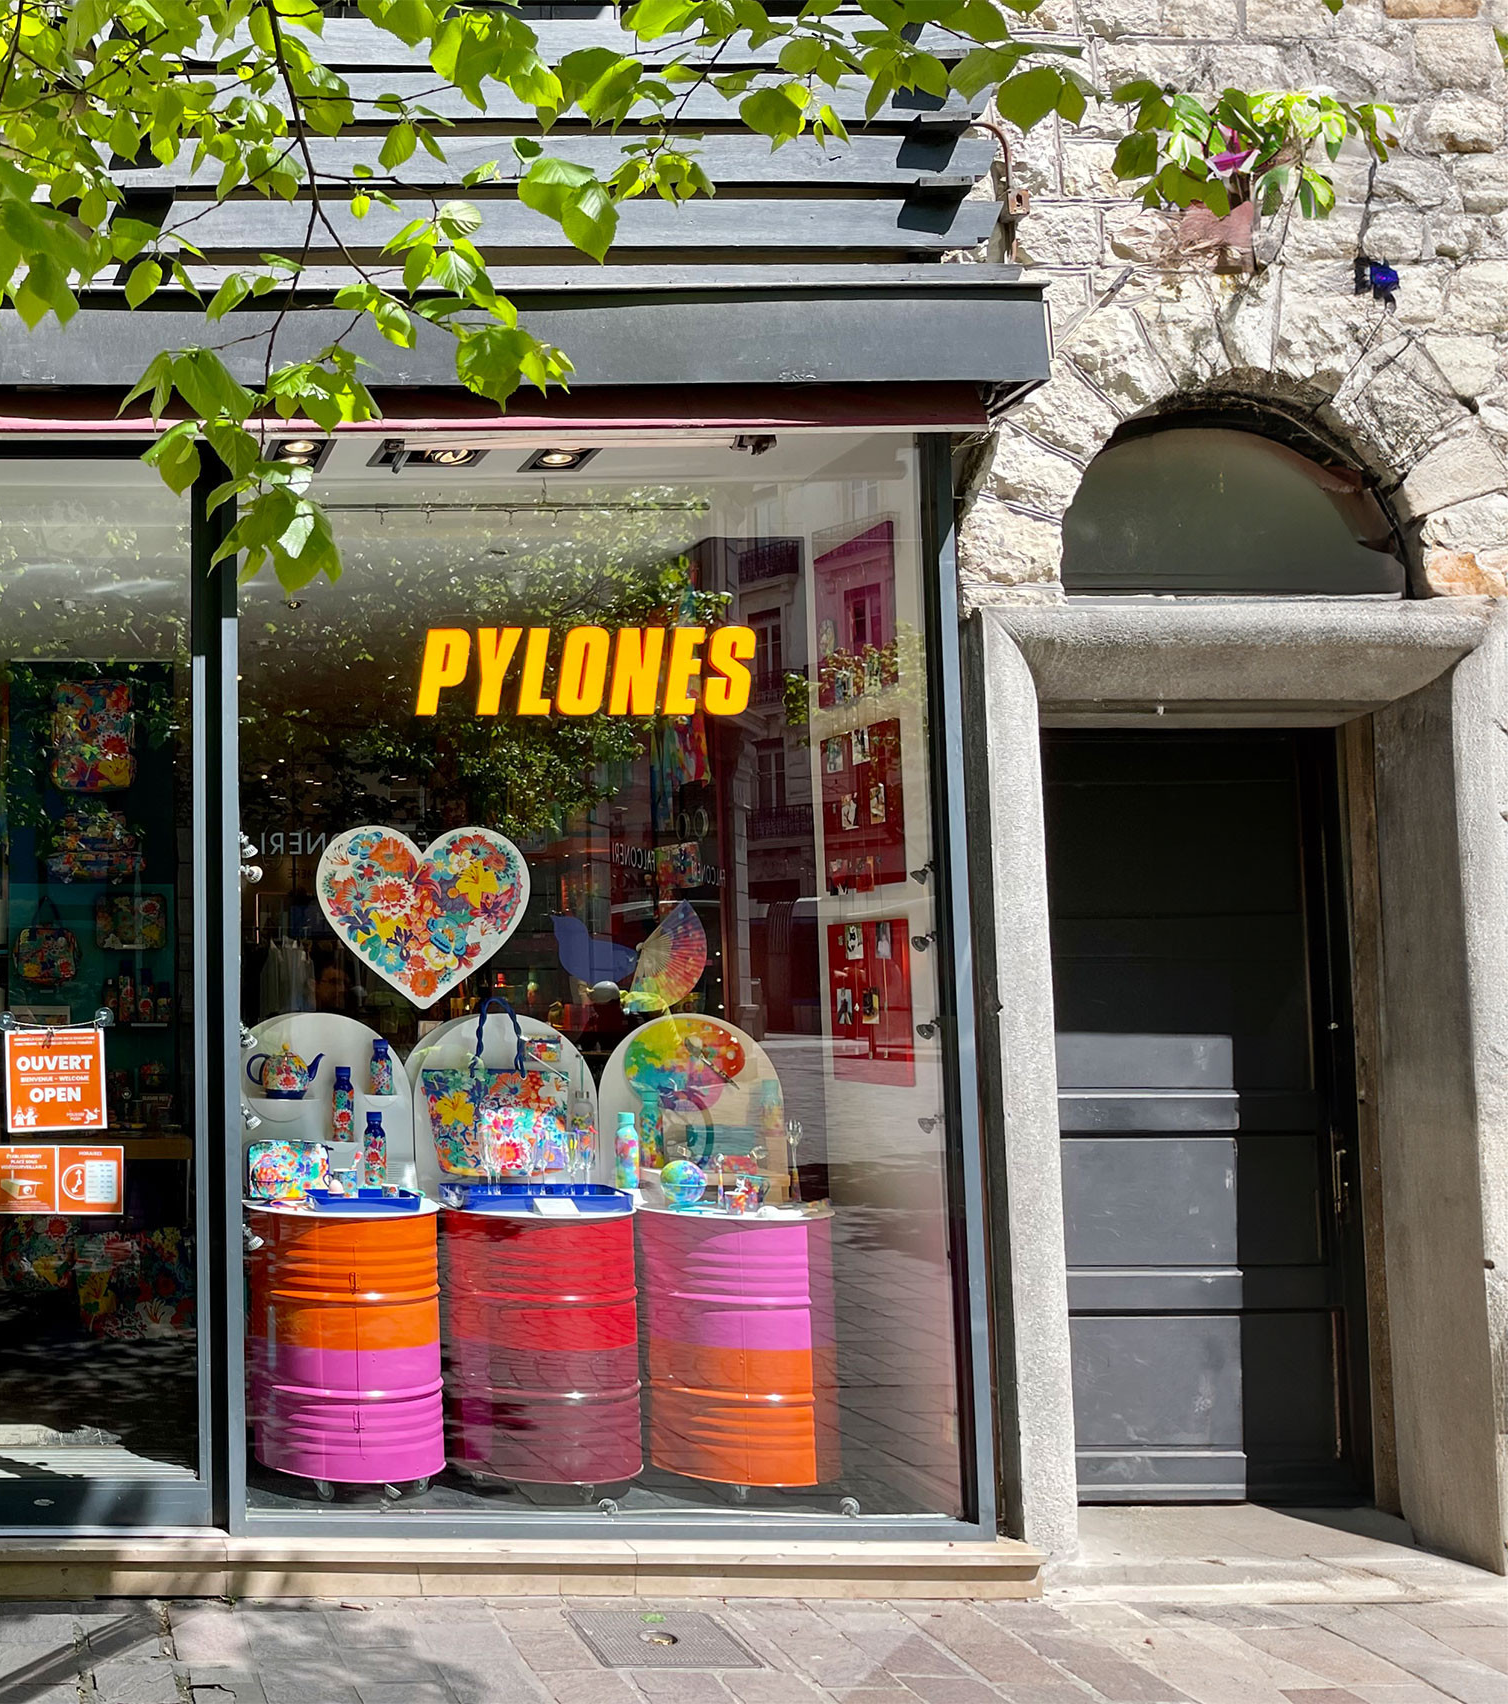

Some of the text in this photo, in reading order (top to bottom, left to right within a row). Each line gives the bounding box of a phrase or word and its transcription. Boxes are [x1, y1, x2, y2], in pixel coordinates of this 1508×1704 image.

[415, 625, 757, 716] PYLONES
[16, 1055, 93, 1071] OUVERT
[29, 1087, 81, 1103] OPEN
